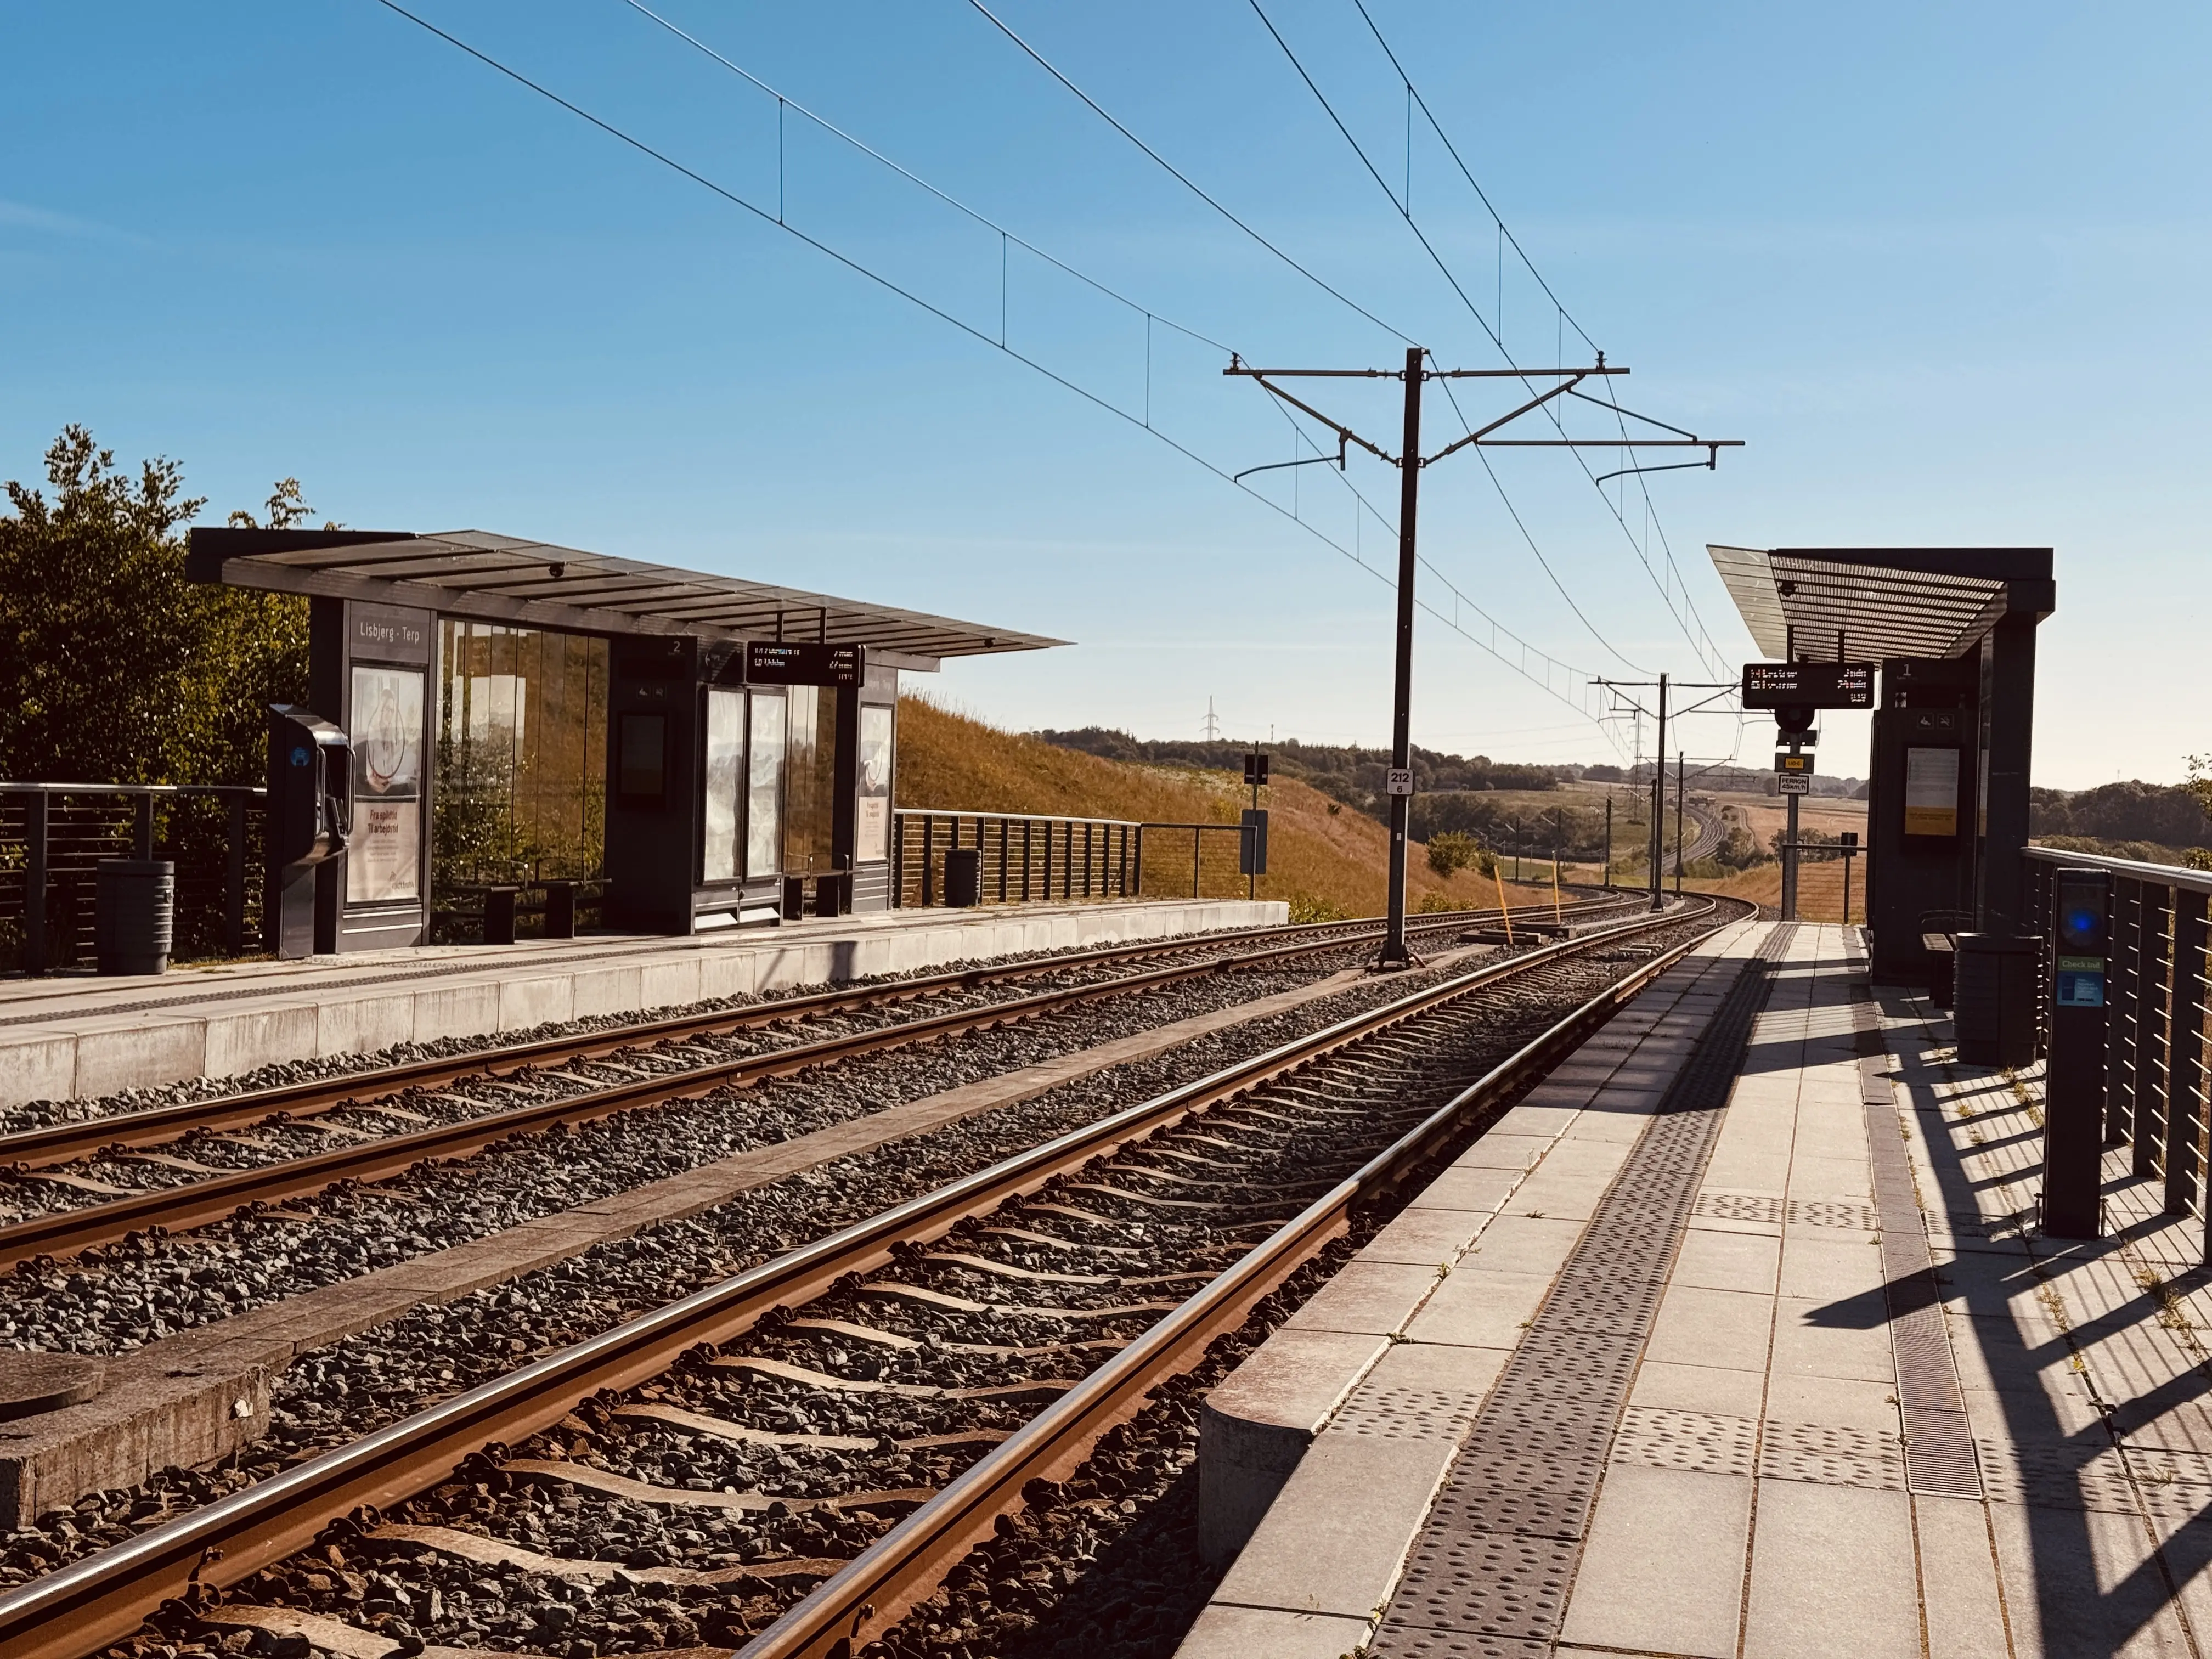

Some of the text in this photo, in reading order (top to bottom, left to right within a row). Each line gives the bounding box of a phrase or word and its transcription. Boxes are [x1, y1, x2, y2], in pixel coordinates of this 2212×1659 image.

[360, 622, 394, 642] Lisbjerg
[402, 627, 420, 645] Terp
[673, 641, 680, 652] 2
[1903, 664, 1911, 676] 1
[1391, 772, 1409, 782] 212
